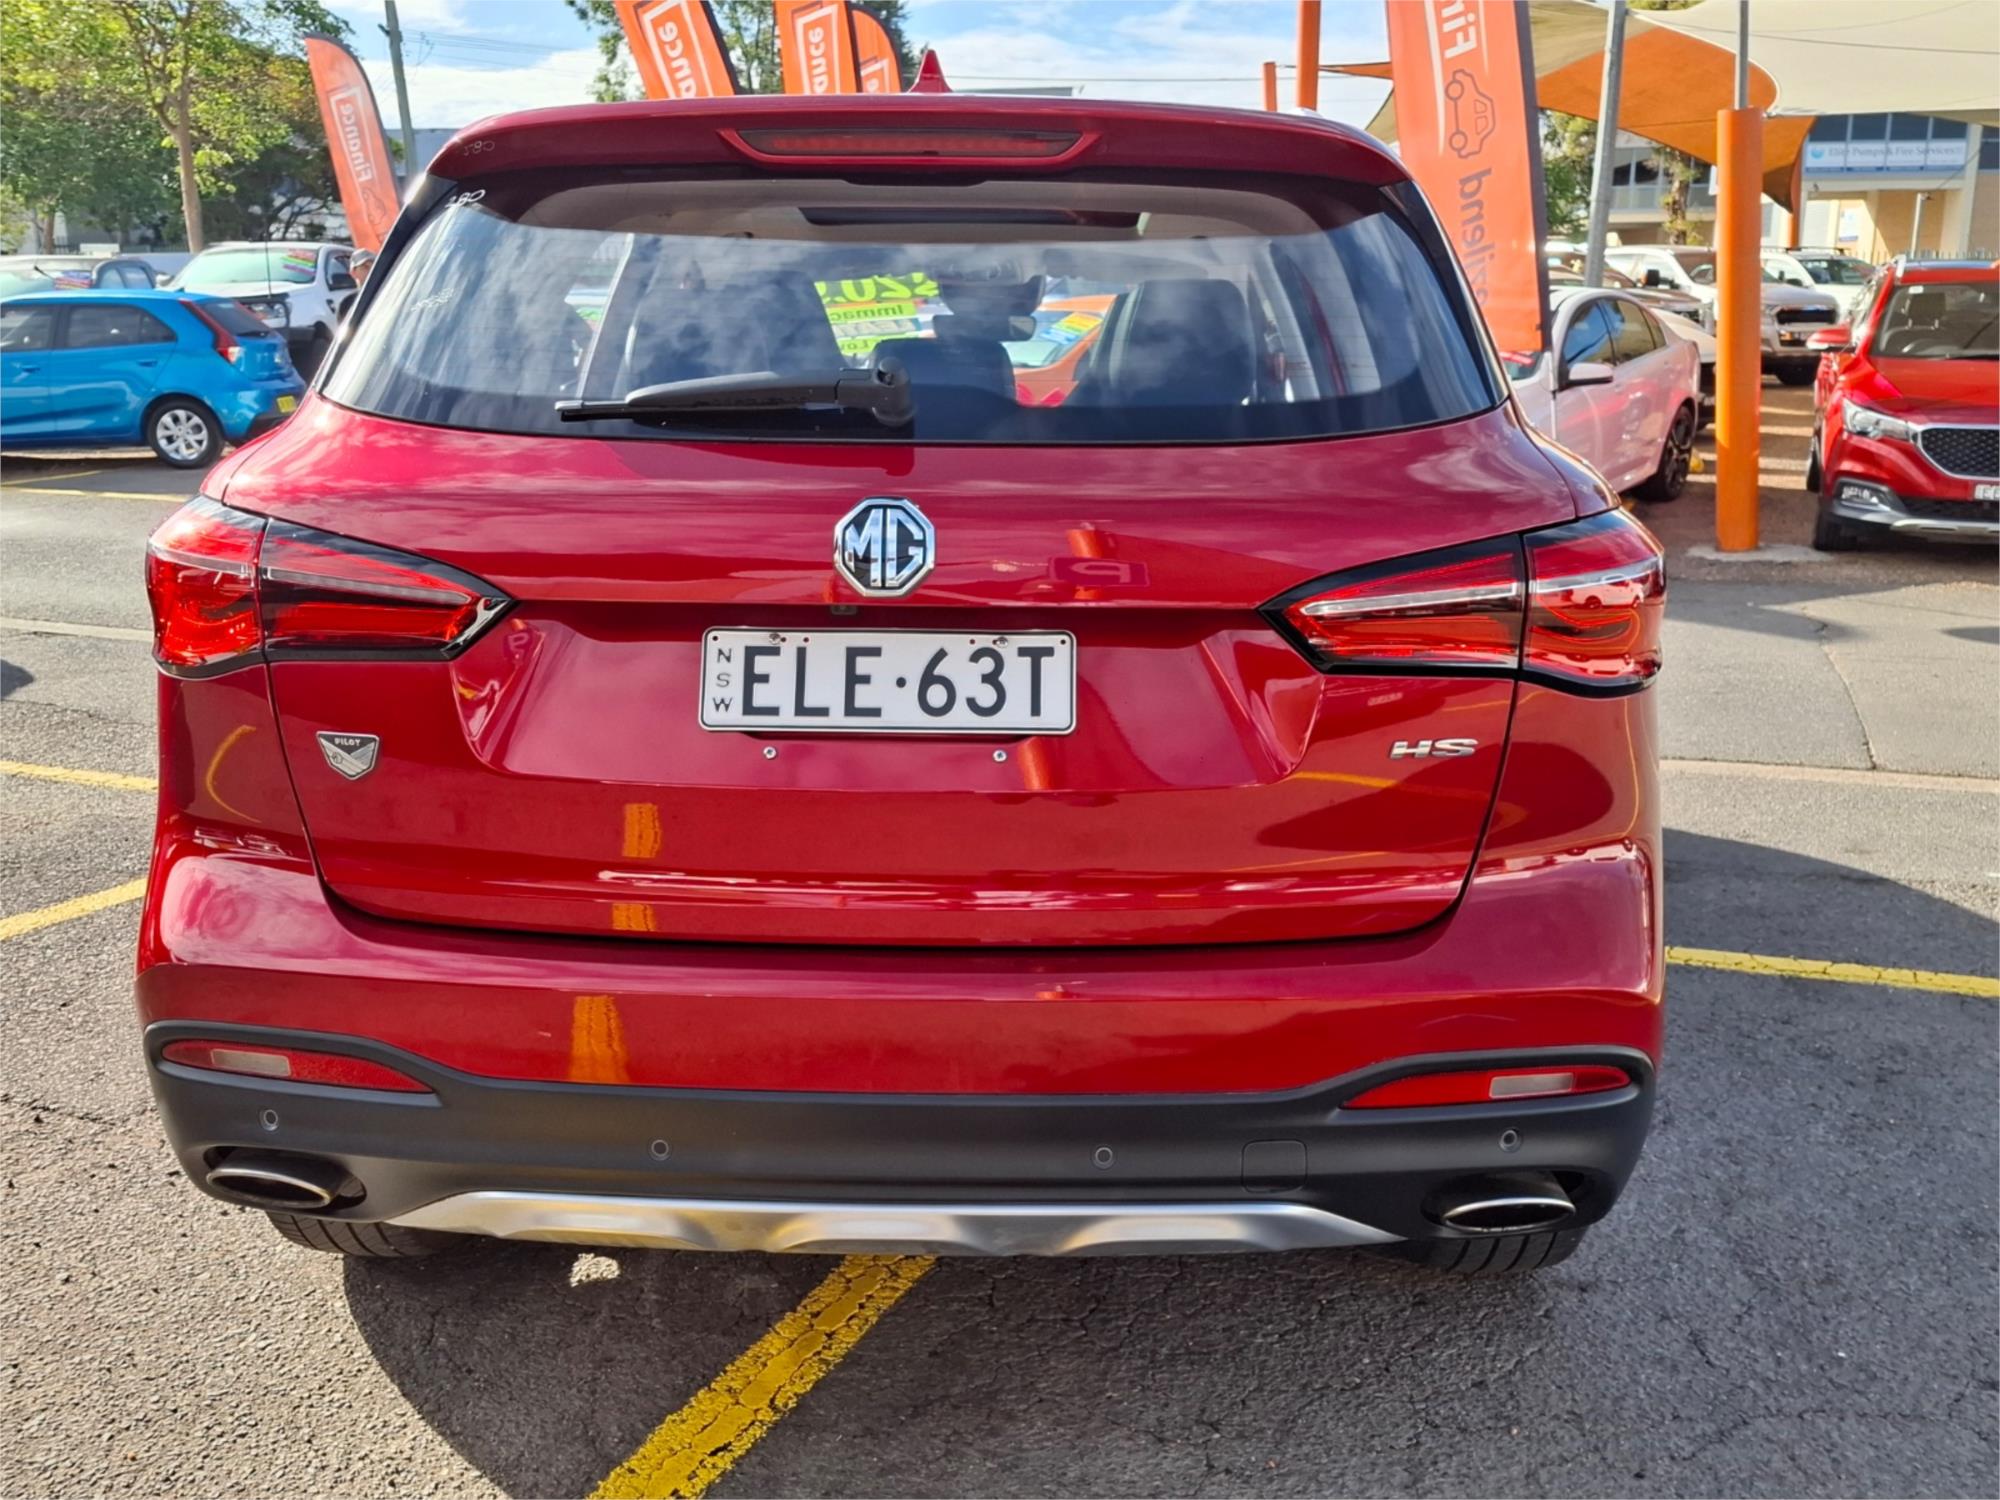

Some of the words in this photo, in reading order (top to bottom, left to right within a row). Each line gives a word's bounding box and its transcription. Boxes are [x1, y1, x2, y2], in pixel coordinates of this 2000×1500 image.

[845, 508, 924, 588] MG
[334, 737, 361, 746] PILOT
[1390, 738, 1478, 759] HS
